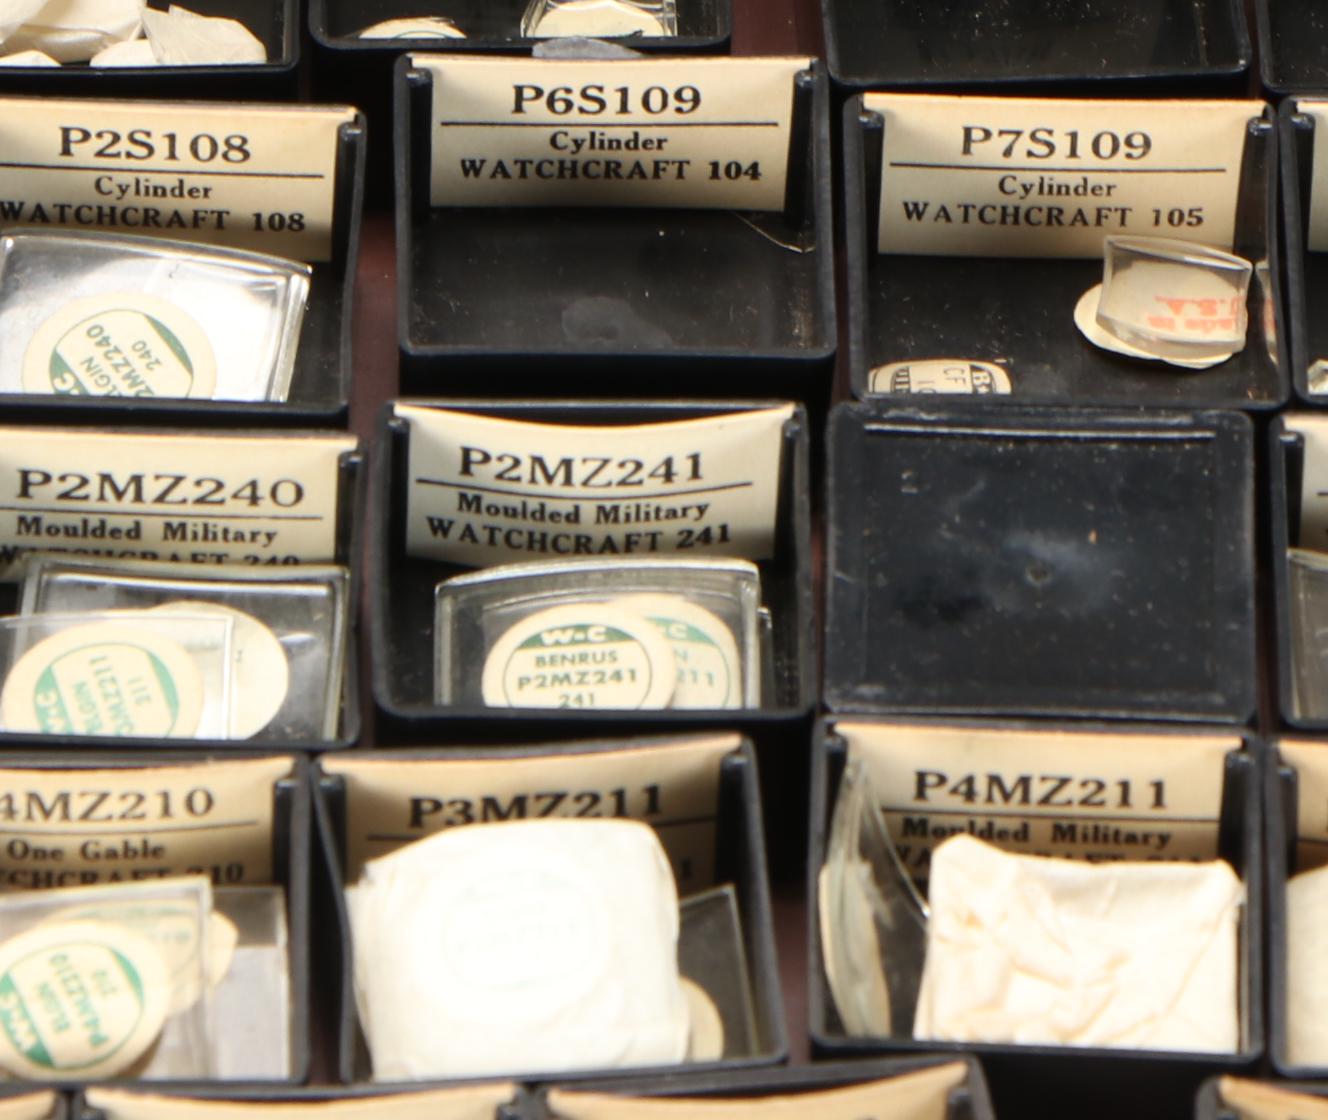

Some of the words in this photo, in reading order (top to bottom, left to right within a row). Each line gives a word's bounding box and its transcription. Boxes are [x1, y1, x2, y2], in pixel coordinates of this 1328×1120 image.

[512, 85, 701, 115] P6S109
[60, 127, 250, 163] P2S108
[550, 131, 667, 155] Cylinder
[963, 127, 1151, 159] P7S109
[95, 177, 211, 200] Cylinder
[999, 176, 1116, 199] Cylinder
[903, 202, 1131, 227] WATCHCRAFT
[1153, 208, 1203, 227] 105
[132, 340, 162, 371] 240
[460, 447, 701, 487] P2MZ241
[18, 470, 303, 506] P2MZ240
[458, 492, 580, 524] Moulded
[596, 504, 708, 524] Military
[18, 516, 141, 540] Moulded
[163, 522, 276, 547] Military
[535, 650, 618, 666] BENRUS
[518, 668, 638, 689] P2MZ241
[559, 693, 595, 707] 241
[915, 771, 1164, 808] P4MZ211
[408, 786, 661, 827] P3MZ211
[8, 841, 65, 859] One
[81, 840, 161, 858] Gable
[1052, 824, 1169, 850] Military
